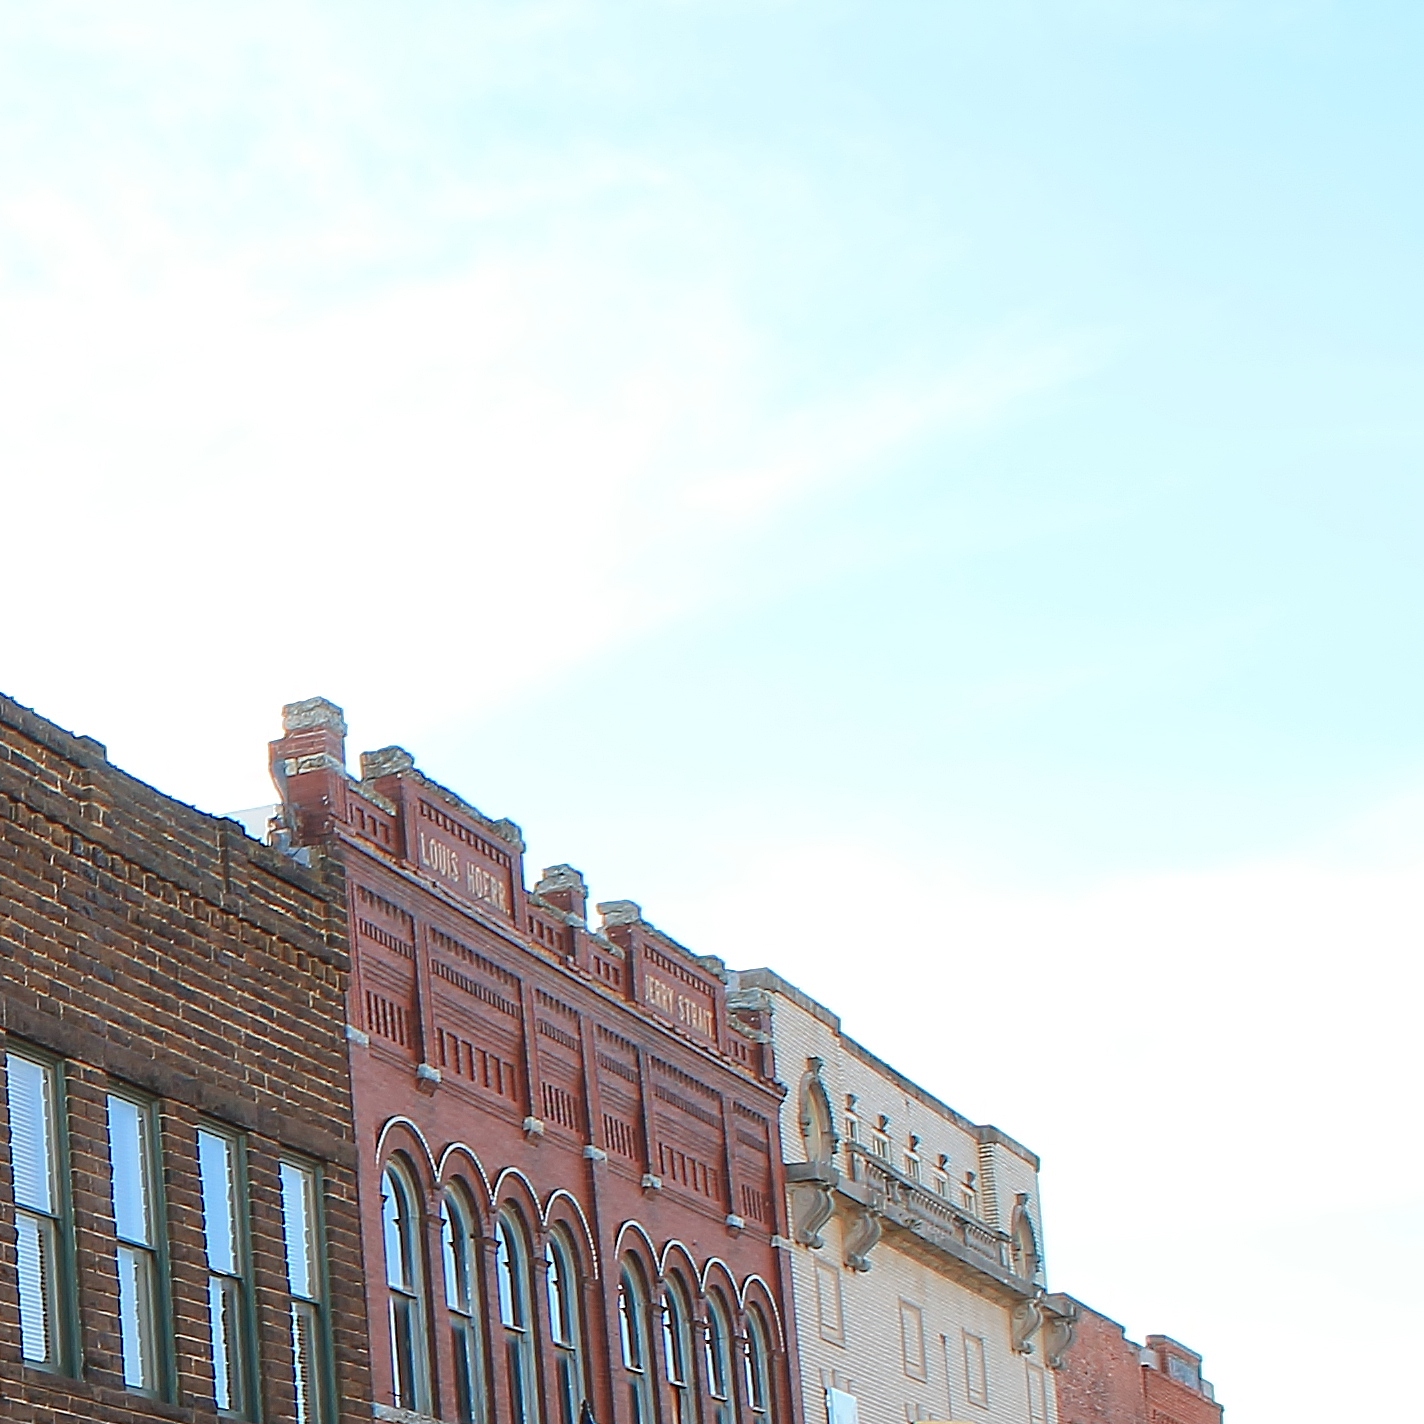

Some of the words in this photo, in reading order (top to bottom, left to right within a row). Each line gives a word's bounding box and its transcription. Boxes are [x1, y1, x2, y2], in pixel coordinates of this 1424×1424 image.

[420, 832, 459, 882] LOUIS
[645, 973, 673, 1014] JERRY
[678, 995, 713, 1038] STRAIT
